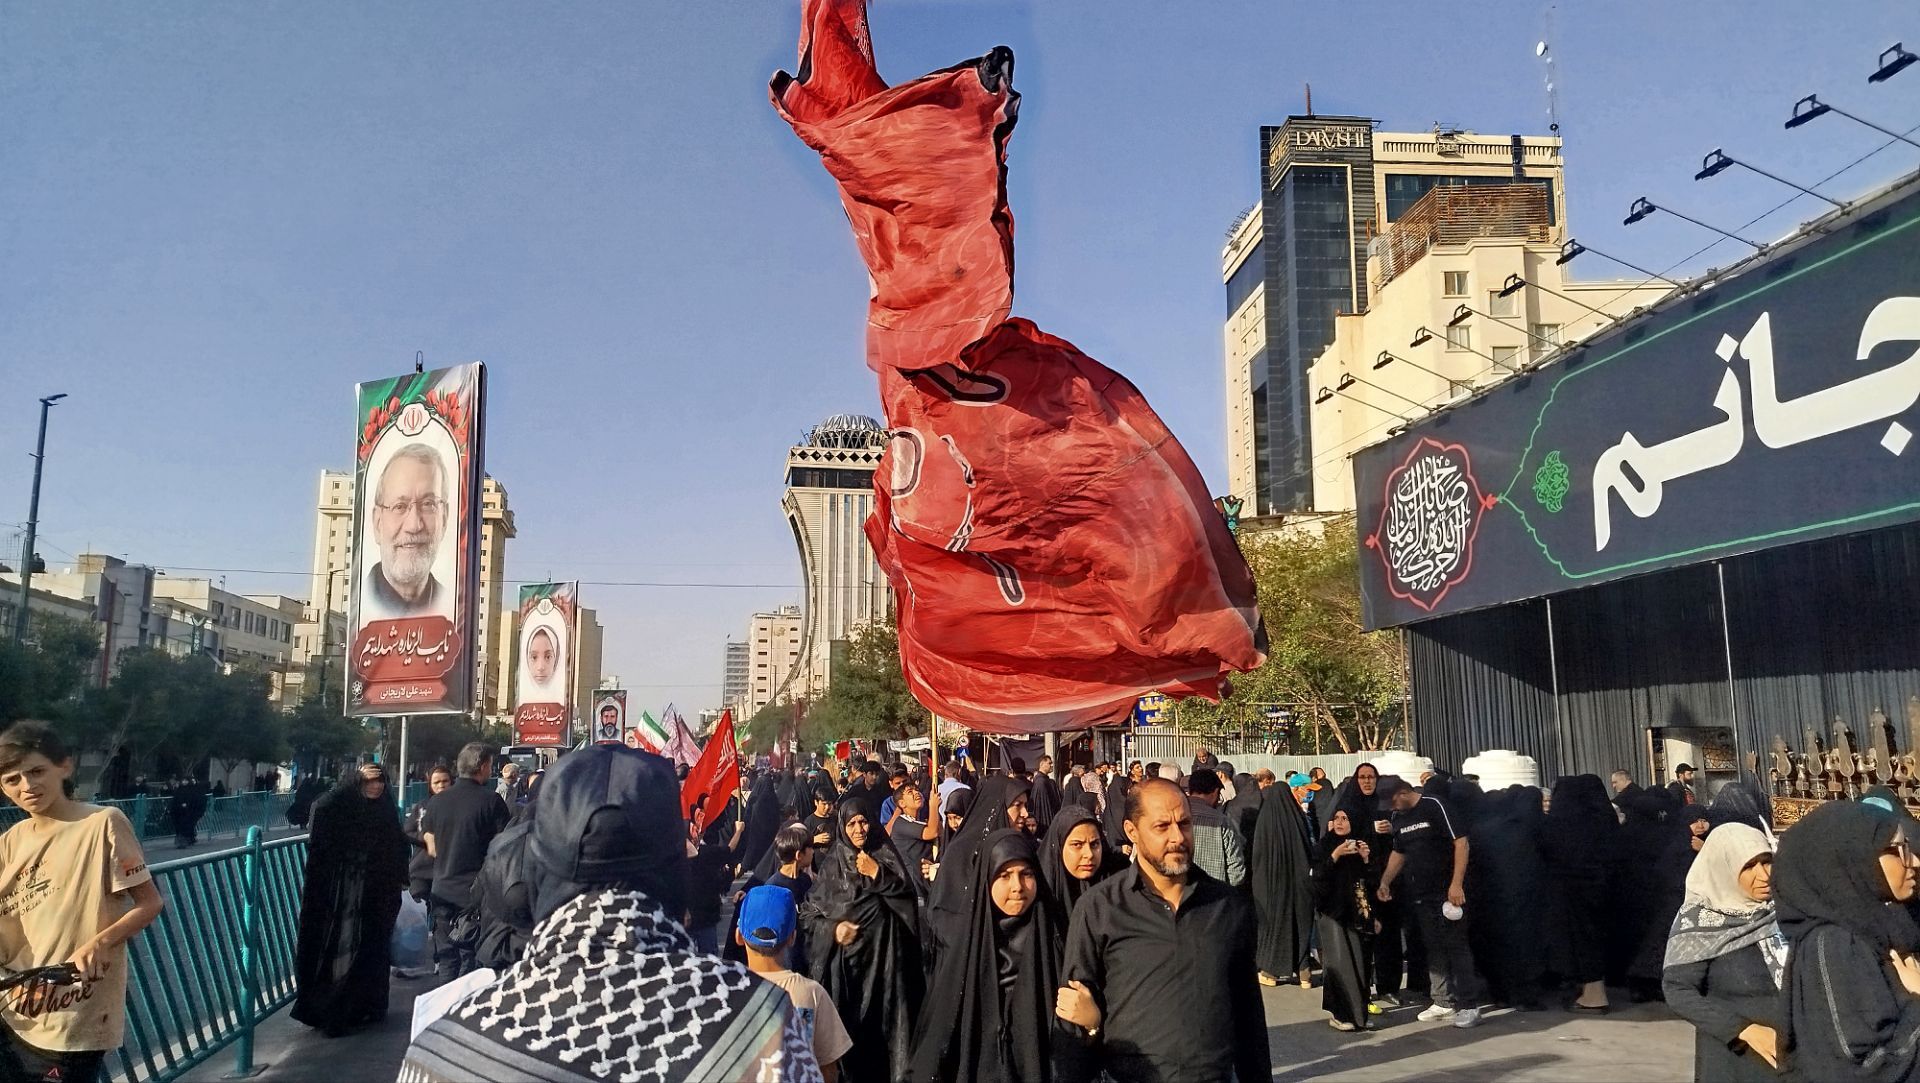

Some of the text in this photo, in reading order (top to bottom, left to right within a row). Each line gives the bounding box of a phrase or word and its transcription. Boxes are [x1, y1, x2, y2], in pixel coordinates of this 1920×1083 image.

[1296, 129, 1365, 149] DARVISHI
[416, 628, 453, 664] نایب
[418, 686, 433, 696] شهید
